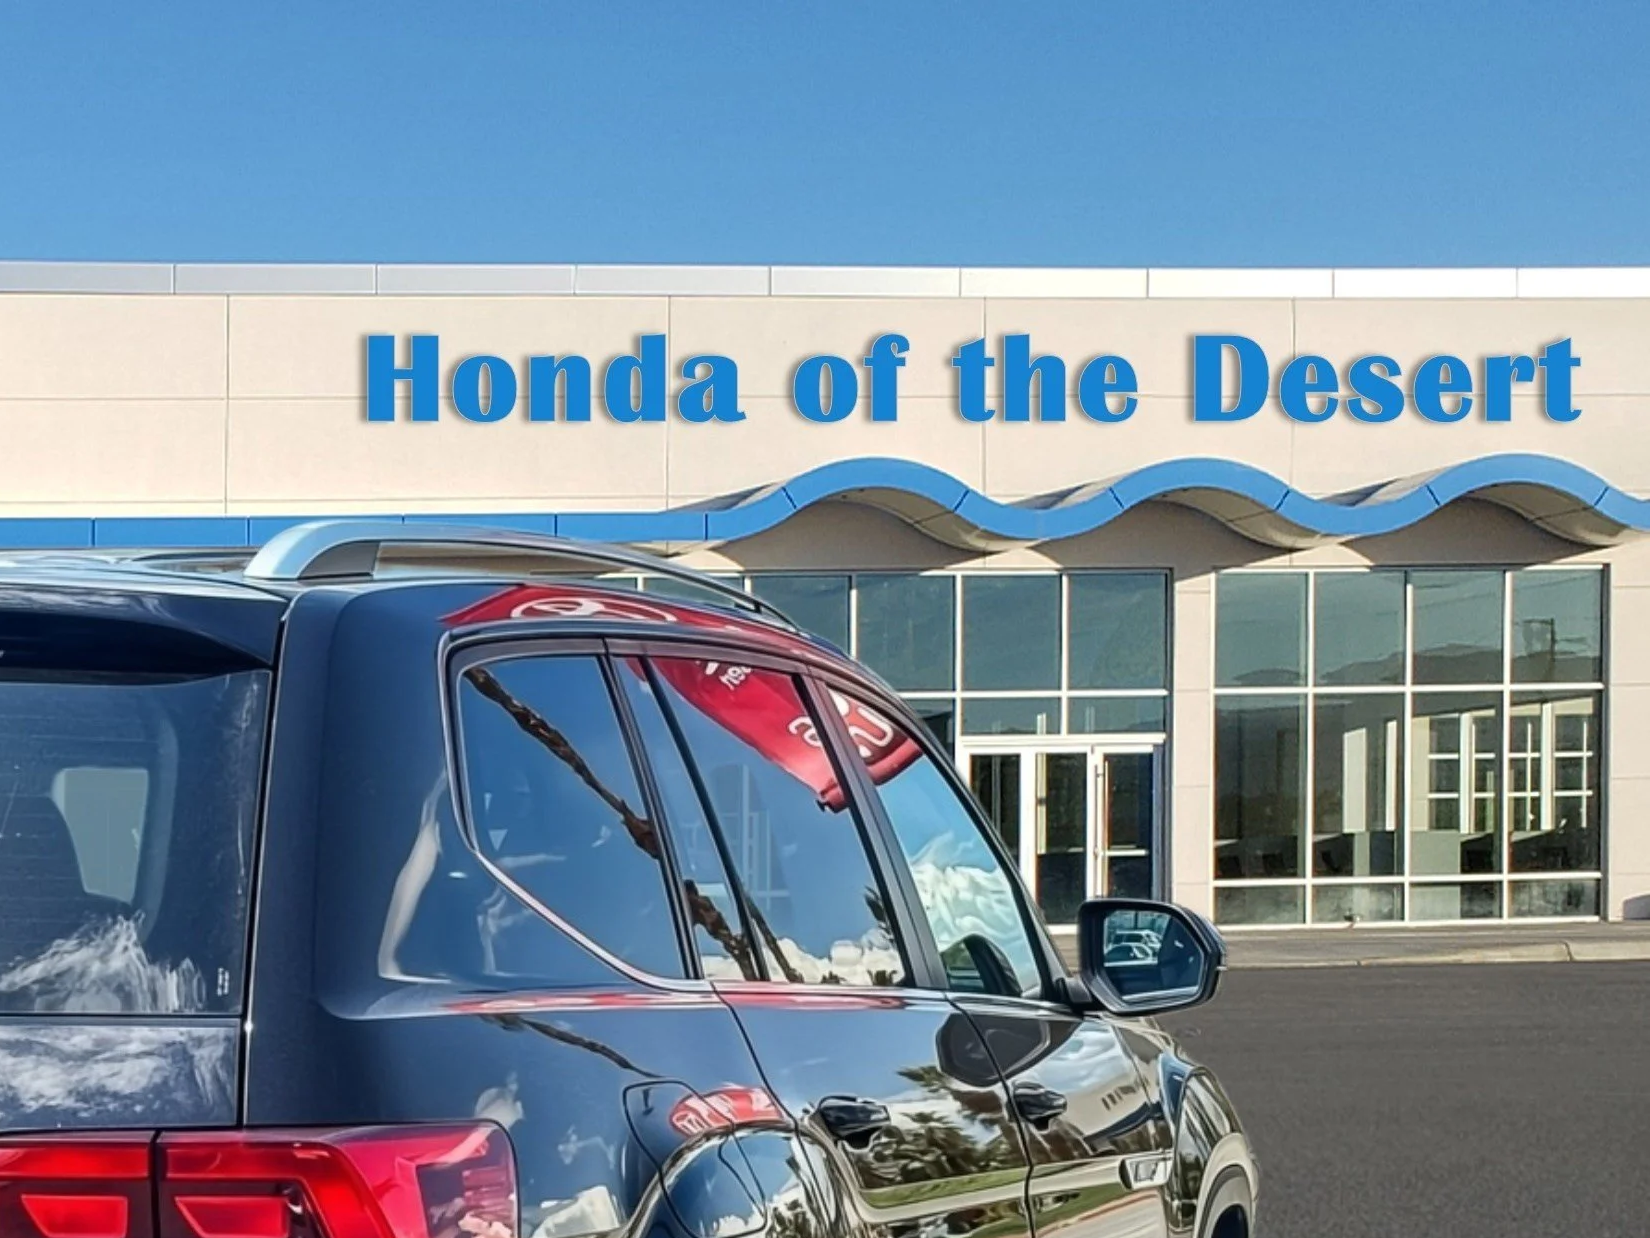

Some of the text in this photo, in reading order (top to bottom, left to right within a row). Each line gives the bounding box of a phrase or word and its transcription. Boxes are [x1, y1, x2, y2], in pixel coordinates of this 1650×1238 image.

[367, 333, 1581, 423] Honda of the Desert
